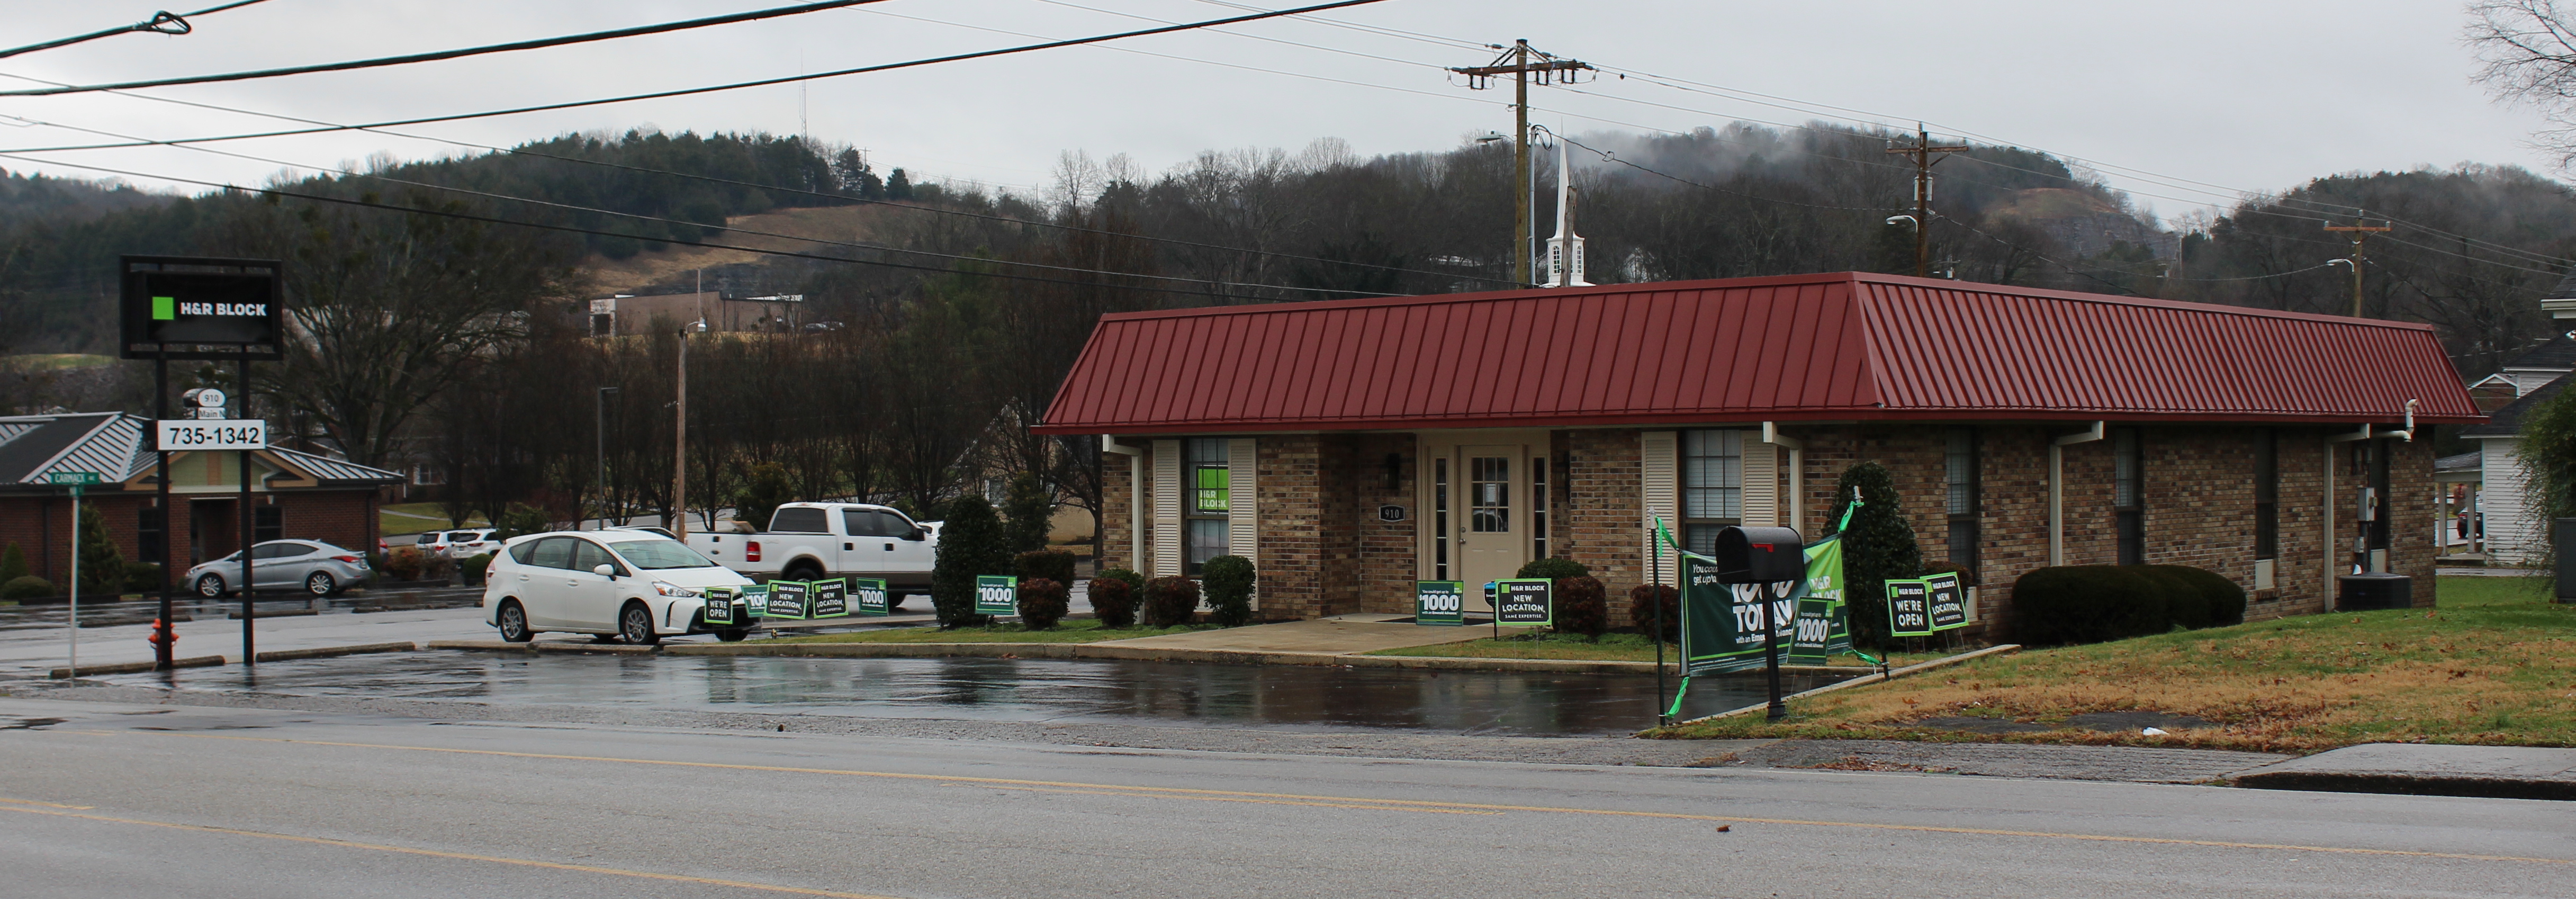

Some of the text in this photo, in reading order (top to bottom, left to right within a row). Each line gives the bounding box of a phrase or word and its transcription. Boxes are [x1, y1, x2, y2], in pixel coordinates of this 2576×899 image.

[180, 302, 266, 316] H&R BLOCK
[169, 427, 259, 444] 735-1342
[1200, 499, 1227, 508] BLOCK
[1385, 509, 1399, 518] 910
[1693, 564, 1704, 573] You
[1694, 575, 1702, 586] get
[1703, 576, 1711, 585] up
[1810, 576, 1831, 590] H&R
[746, 595, 767, 606] $100
[1936, 592, 1950, 601] NEW
[1896, 600, 1922, 612] WE'RE
[709, 609, 727, 617] OPEN
[1898, 614, 1923, 626] OPEN
